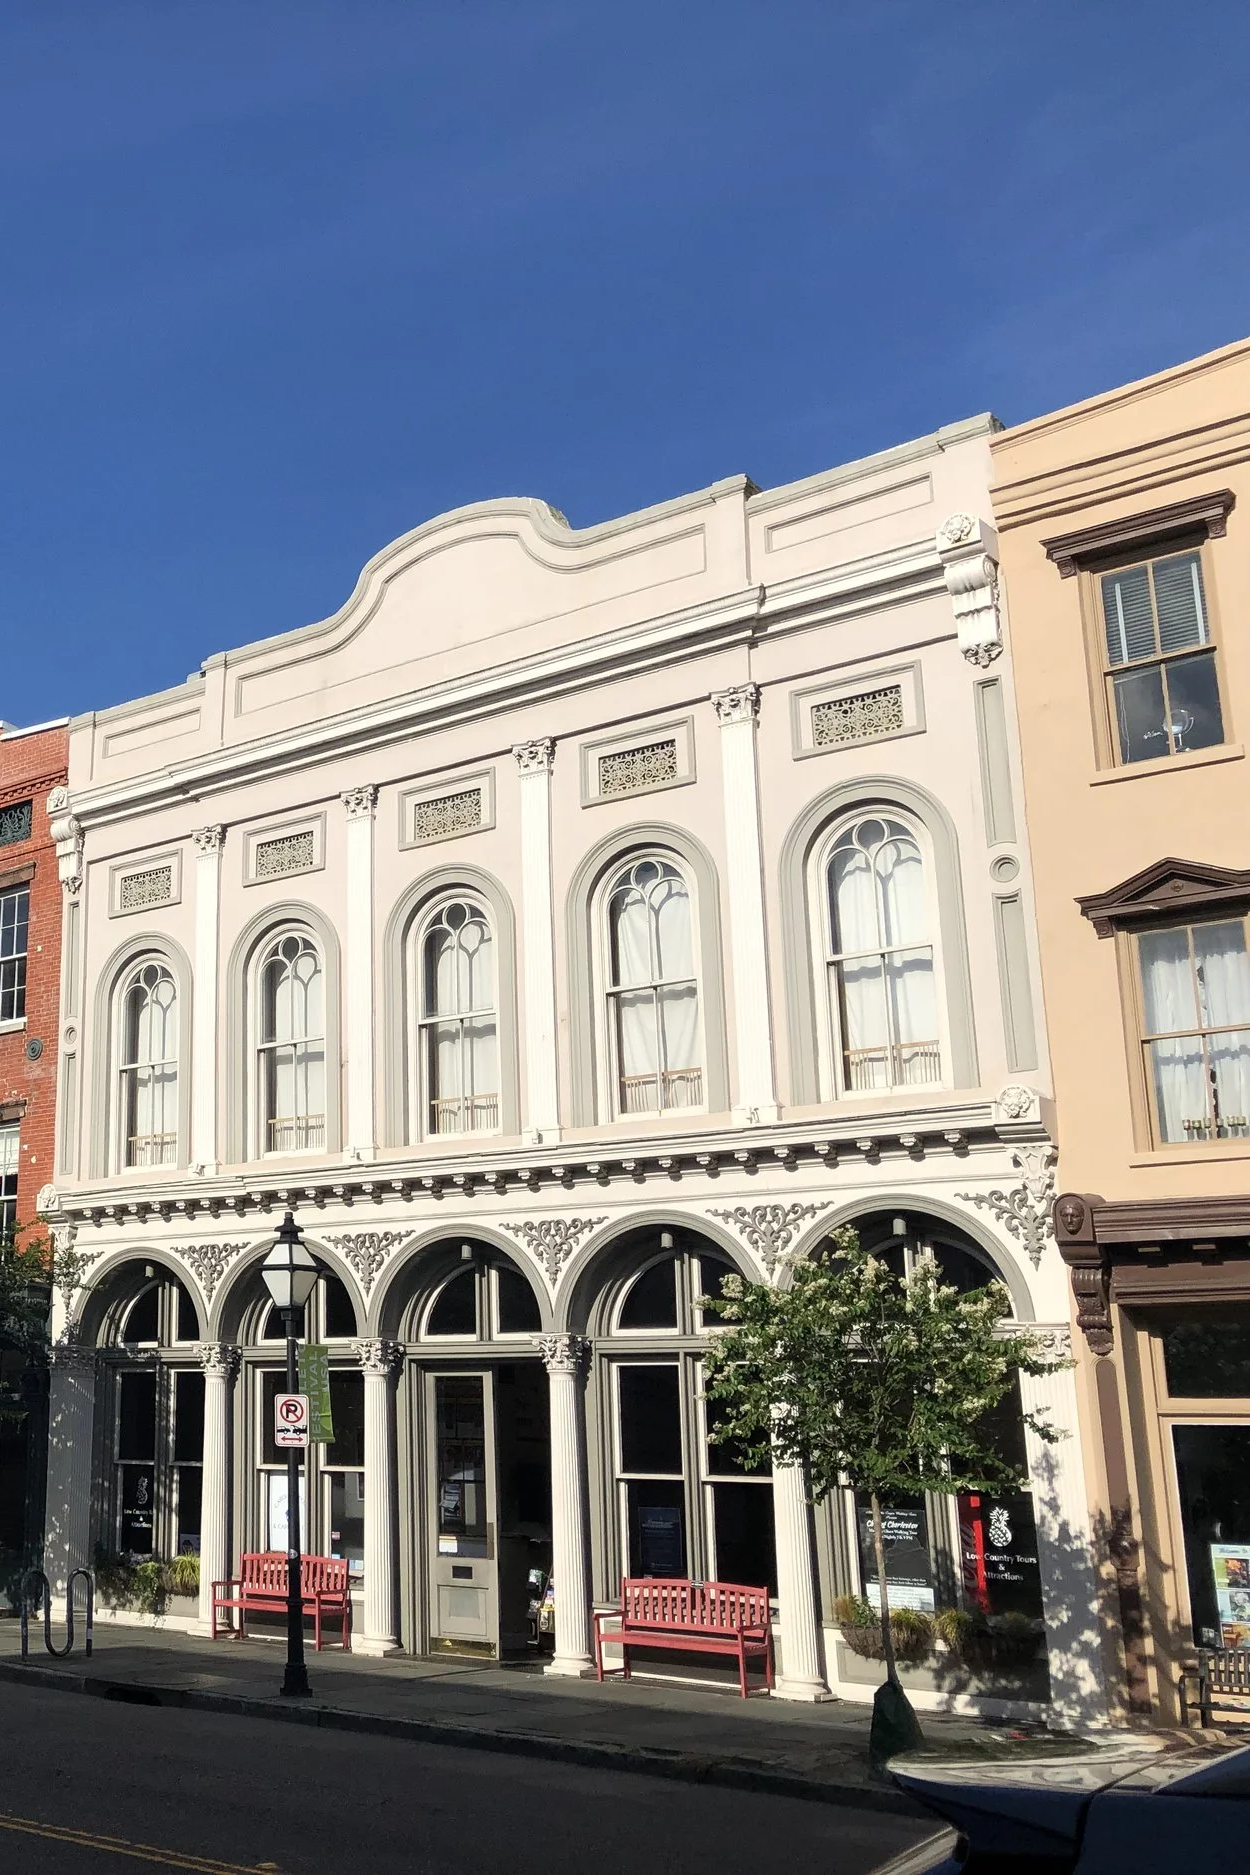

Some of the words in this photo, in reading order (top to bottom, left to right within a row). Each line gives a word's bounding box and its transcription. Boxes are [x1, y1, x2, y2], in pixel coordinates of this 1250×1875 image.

[297, 1344, 307, 1391] LETO
[319, 1354, 330, 1393] USA
[887, 1520, 919, 1530] Charleston
[966, 1552, 982, 1561] Low
[984, 1553, 1014, 1564] Country
[1016, 1555, 1038, 1565] Tours
[998, 1564, 1006, 1572] &
[982, 1571, 1024, 1581] Attractions
